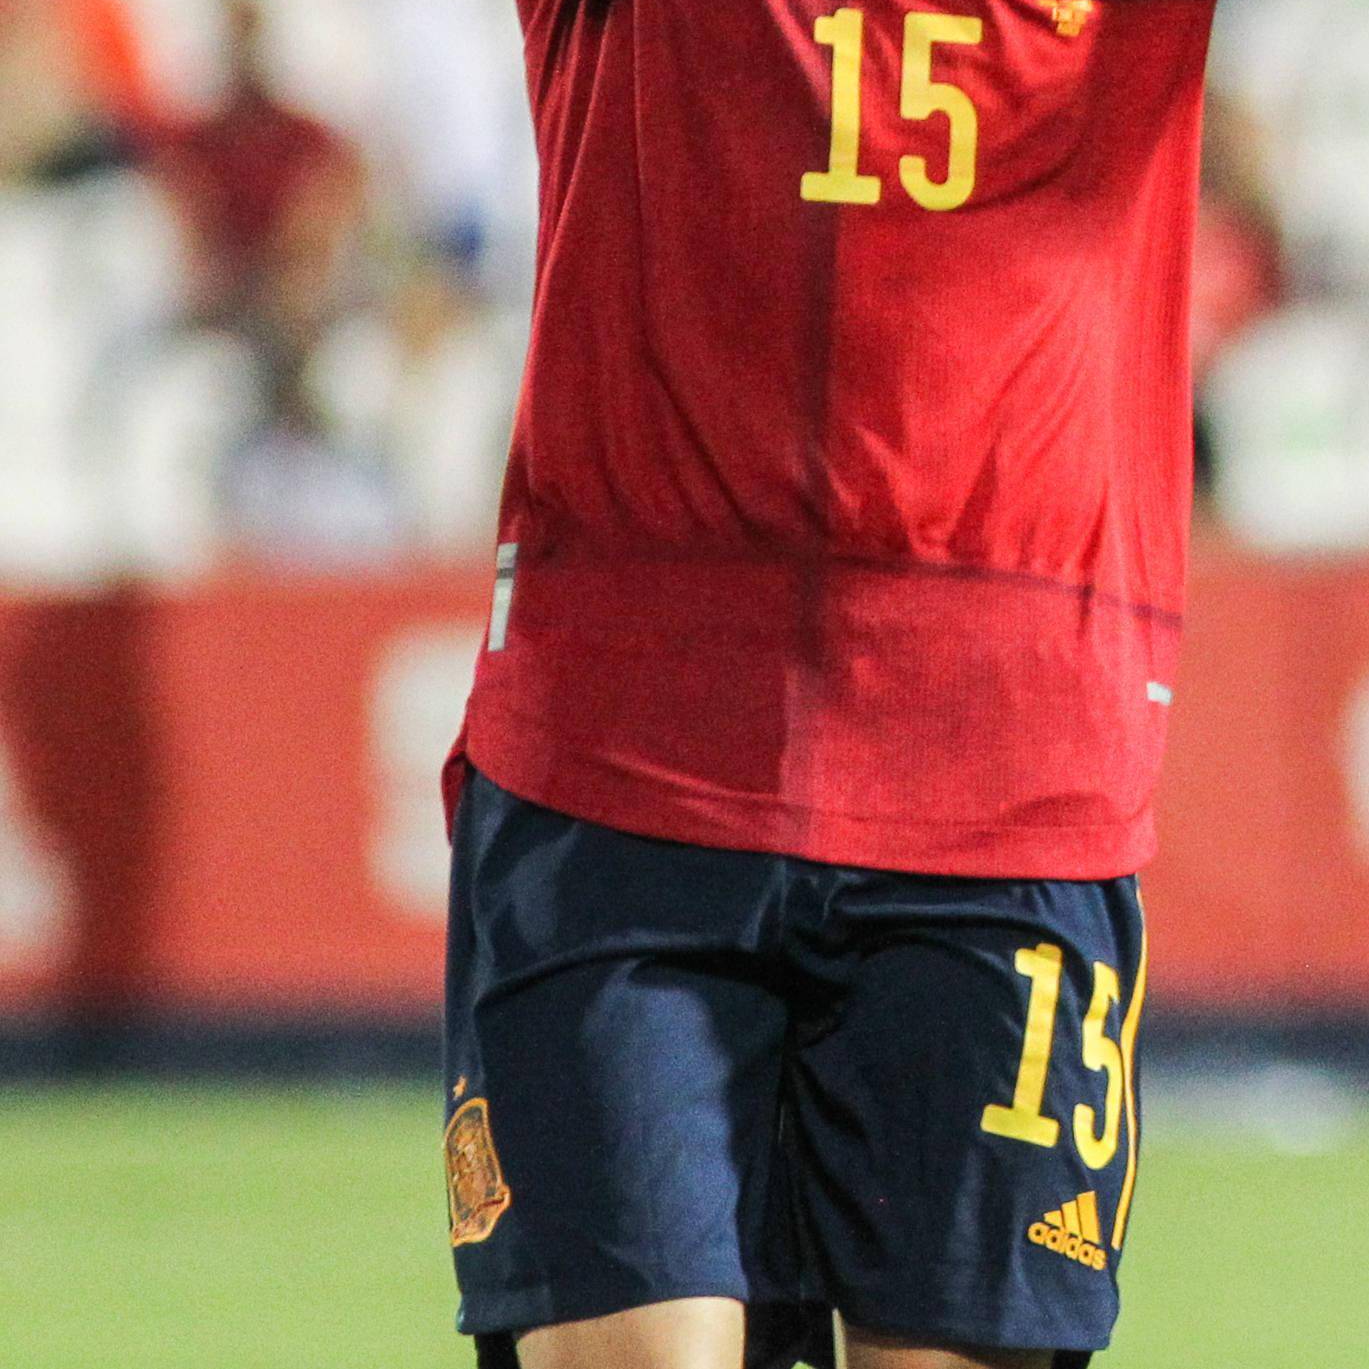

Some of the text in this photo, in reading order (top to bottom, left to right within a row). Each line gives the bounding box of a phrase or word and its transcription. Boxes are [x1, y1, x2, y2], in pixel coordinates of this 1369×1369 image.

[800, 8, 982, 211] 15
[980, 943, 1124, 1169] 15
[1028, 1222, 1107, 1270] adidas
